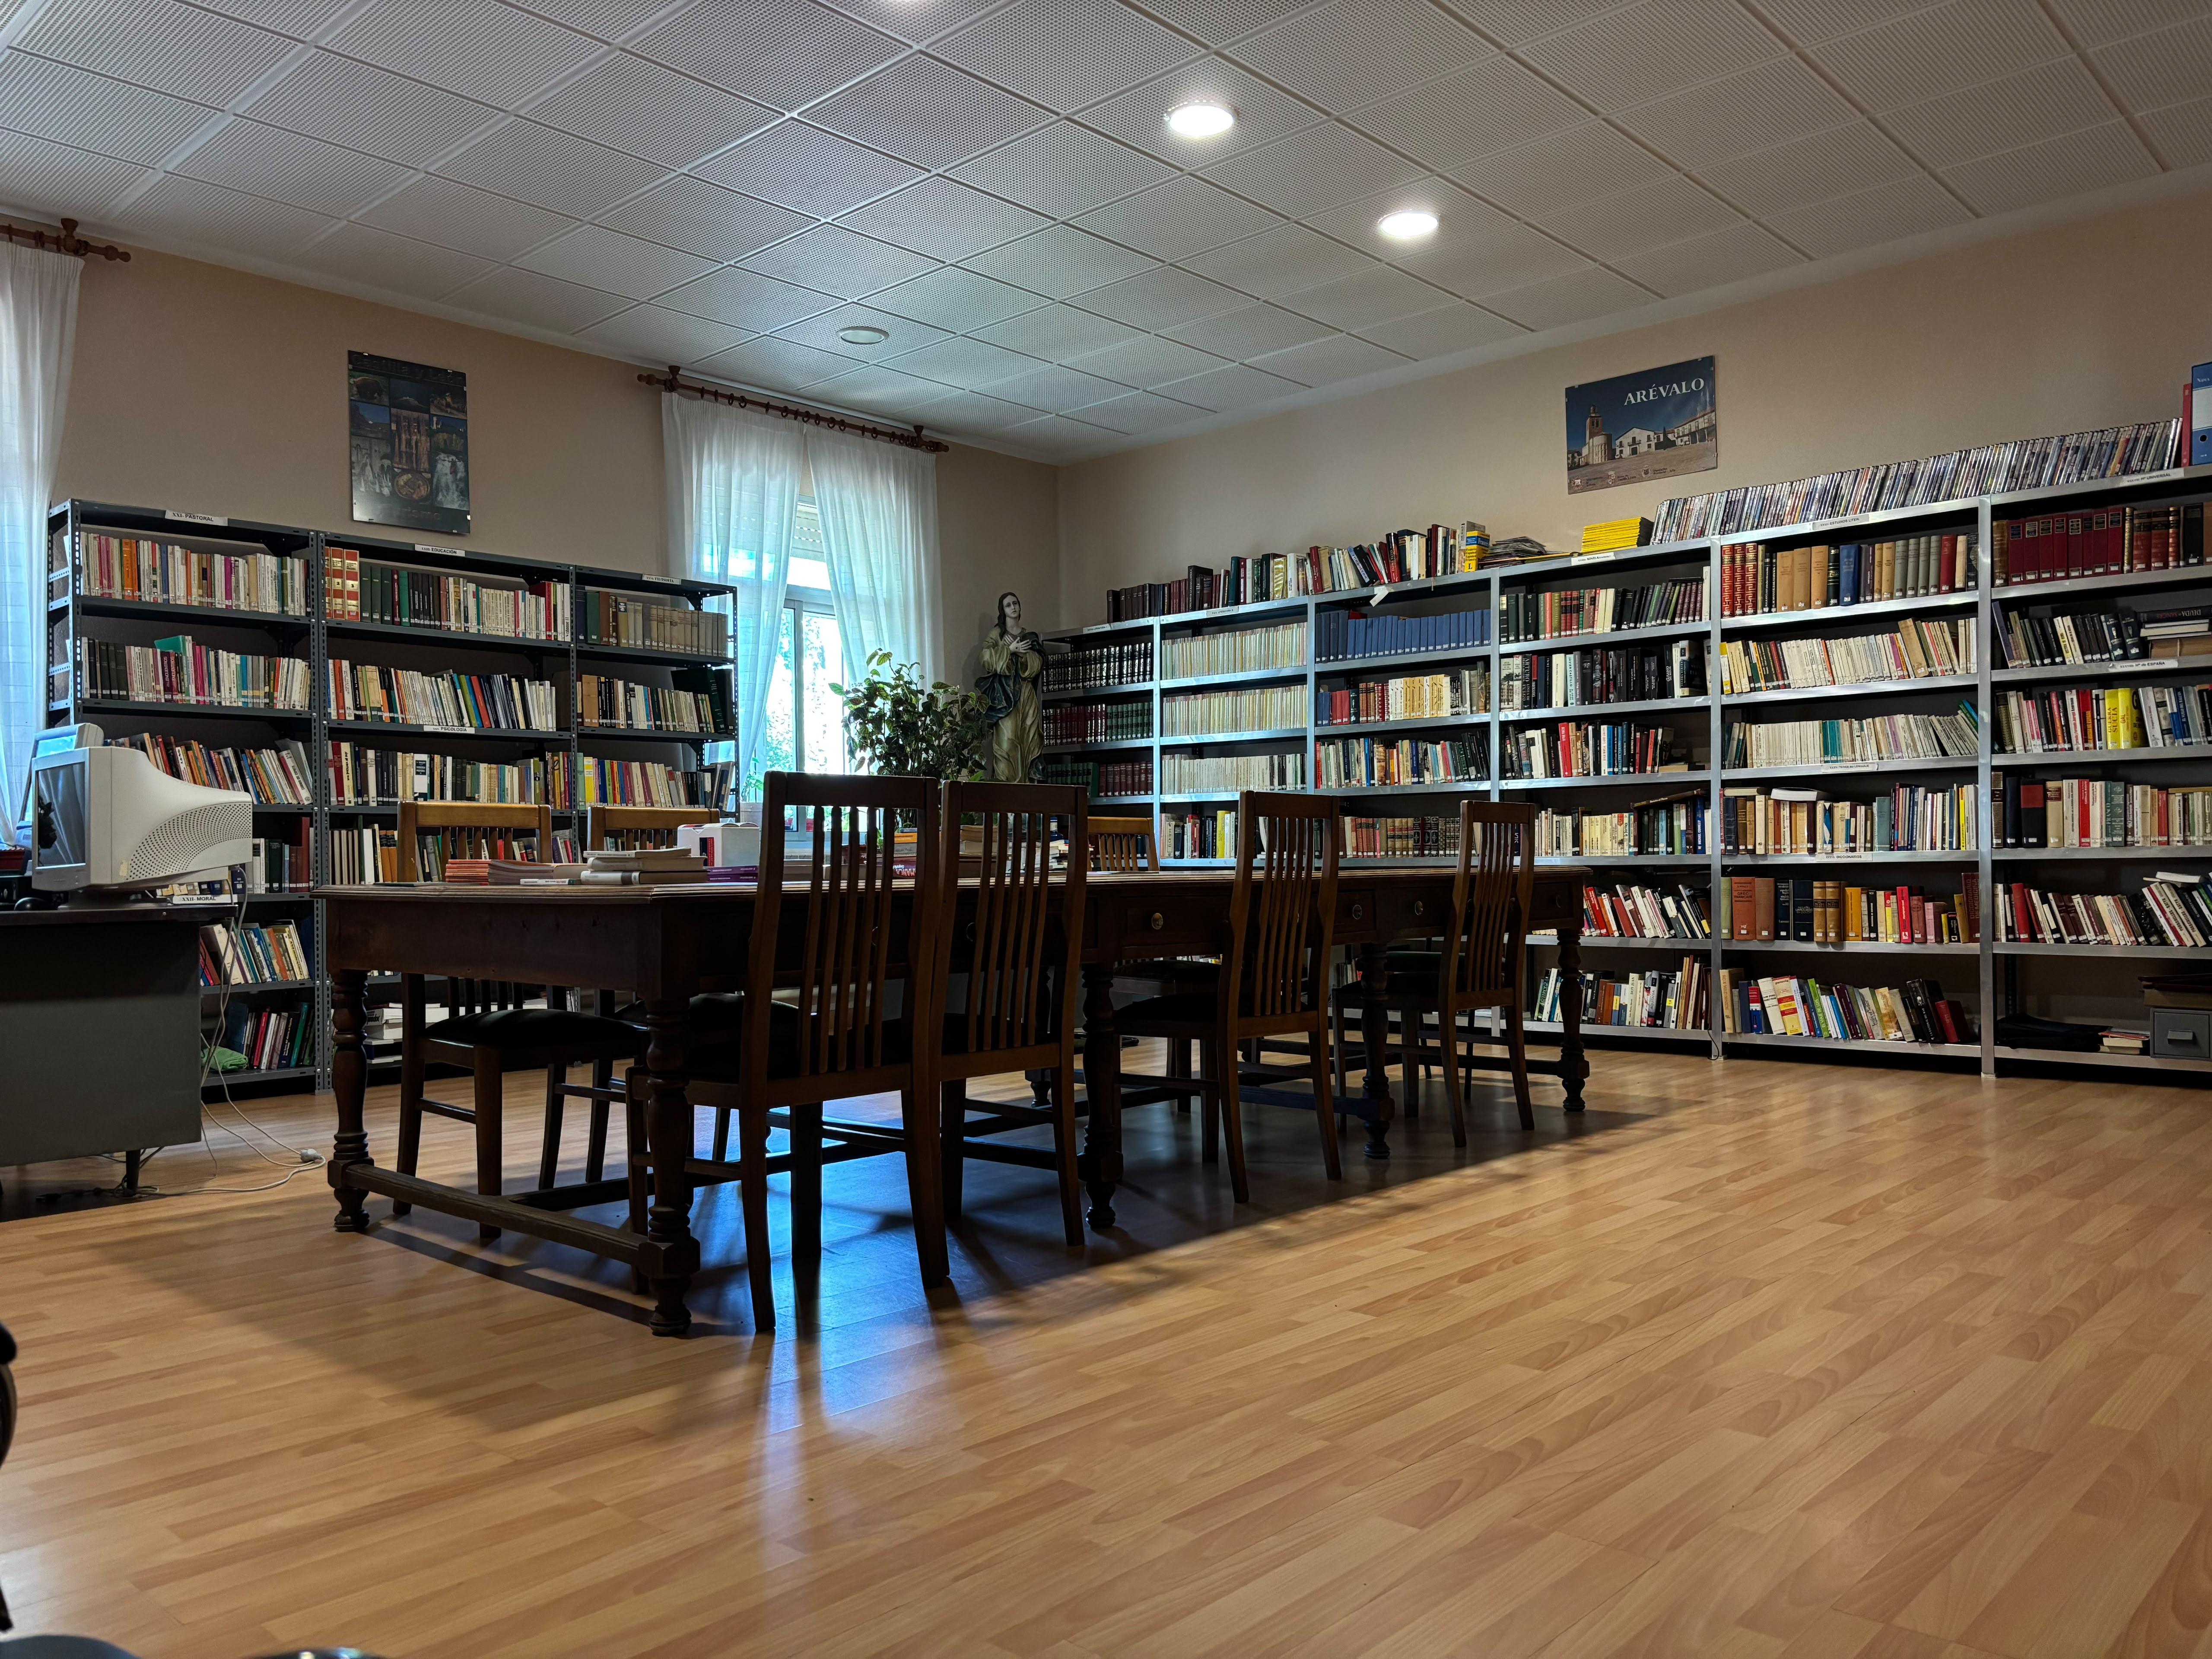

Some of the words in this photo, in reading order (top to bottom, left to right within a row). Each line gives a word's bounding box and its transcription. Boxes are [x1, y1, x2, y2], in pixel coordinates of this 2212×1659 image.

[1624, 378, 1704, 405] ARÉVALO
[185, 514, 214, 522] PASTORAL
[1966, 879, 1975, 919] DICCIONARIO
